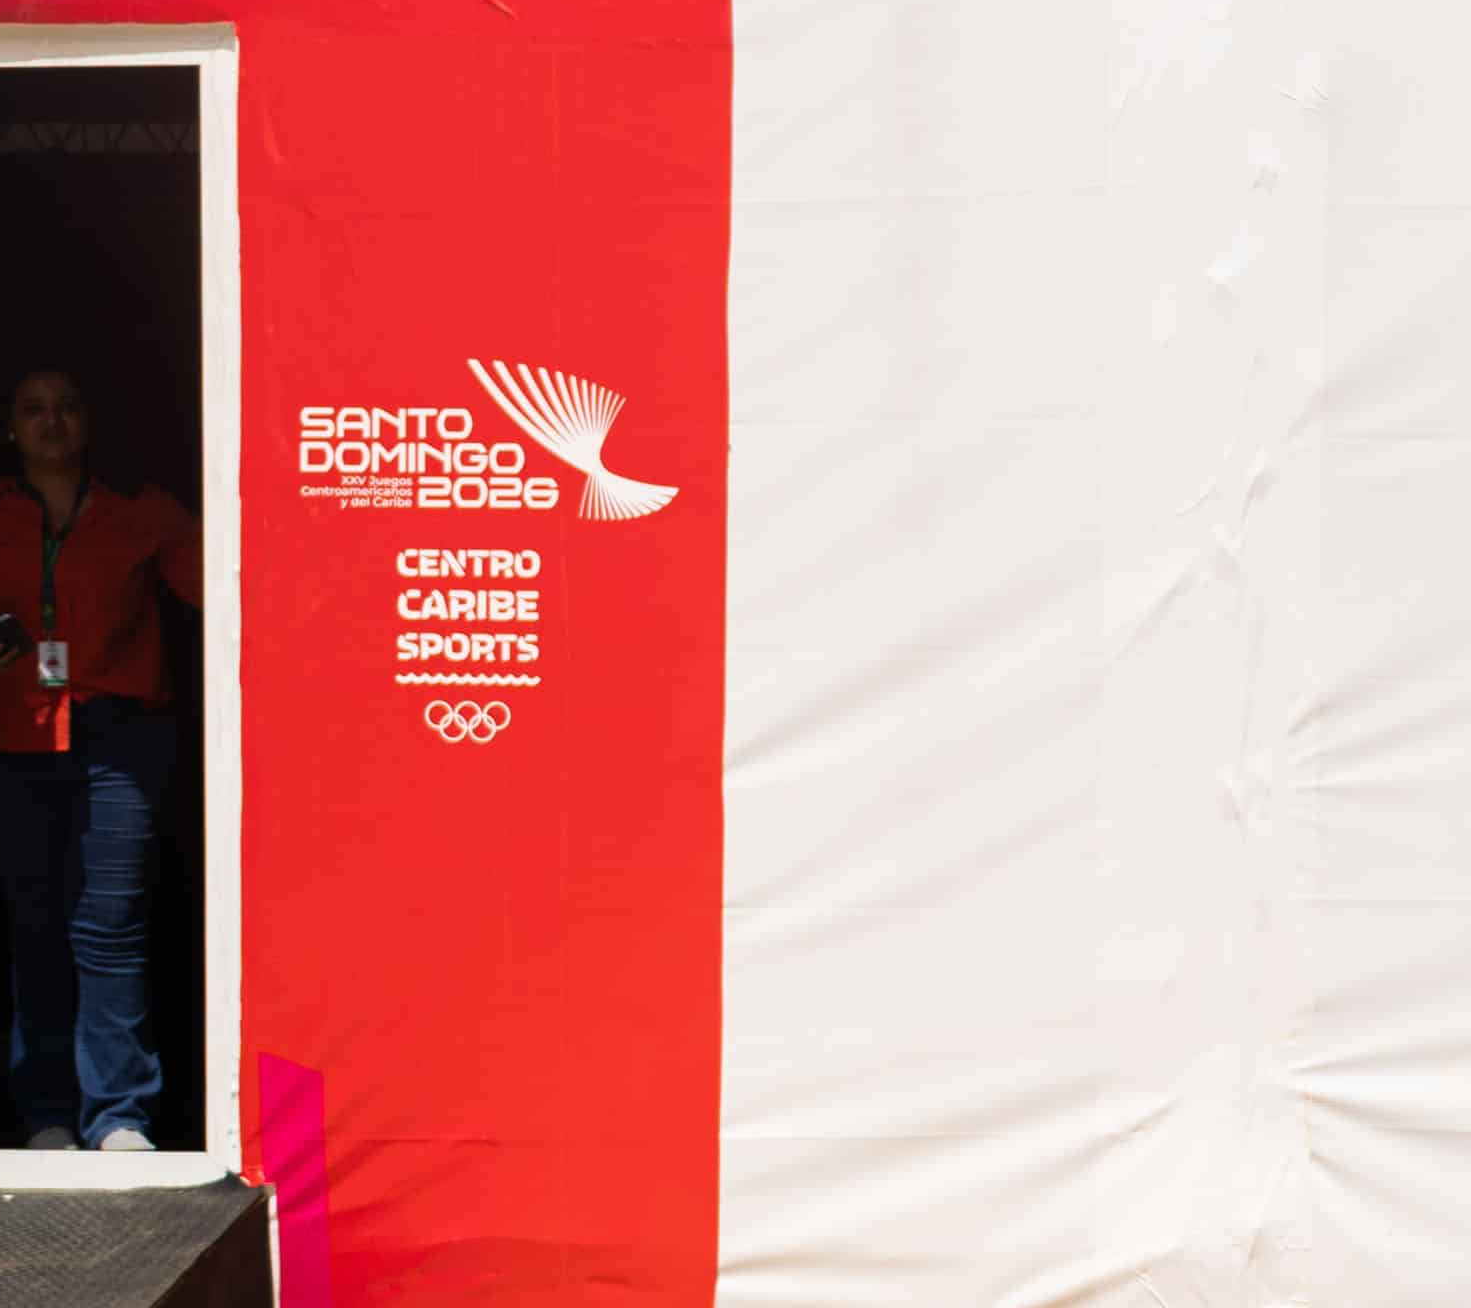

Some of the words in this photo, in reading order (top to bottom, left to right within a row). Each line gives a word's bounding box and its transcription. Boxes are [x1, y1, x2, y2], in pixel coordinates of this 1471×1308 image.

[299, 406, 473, 440] SANTO
[299, 441, 525, 474] DOMINGO
[342, 476, 367, 485] XXV
[370, 476, 413, 487] Juegos
[417, 476, 560, 509] 2026
[351, 497, 370, 507] del
[373, 497, 413, 508] Caribe
[396, 548, 541, 579] CENTRO
[397, 589, 540, 621] CARIBE
[396, 632, 540, 662] SPORTS
